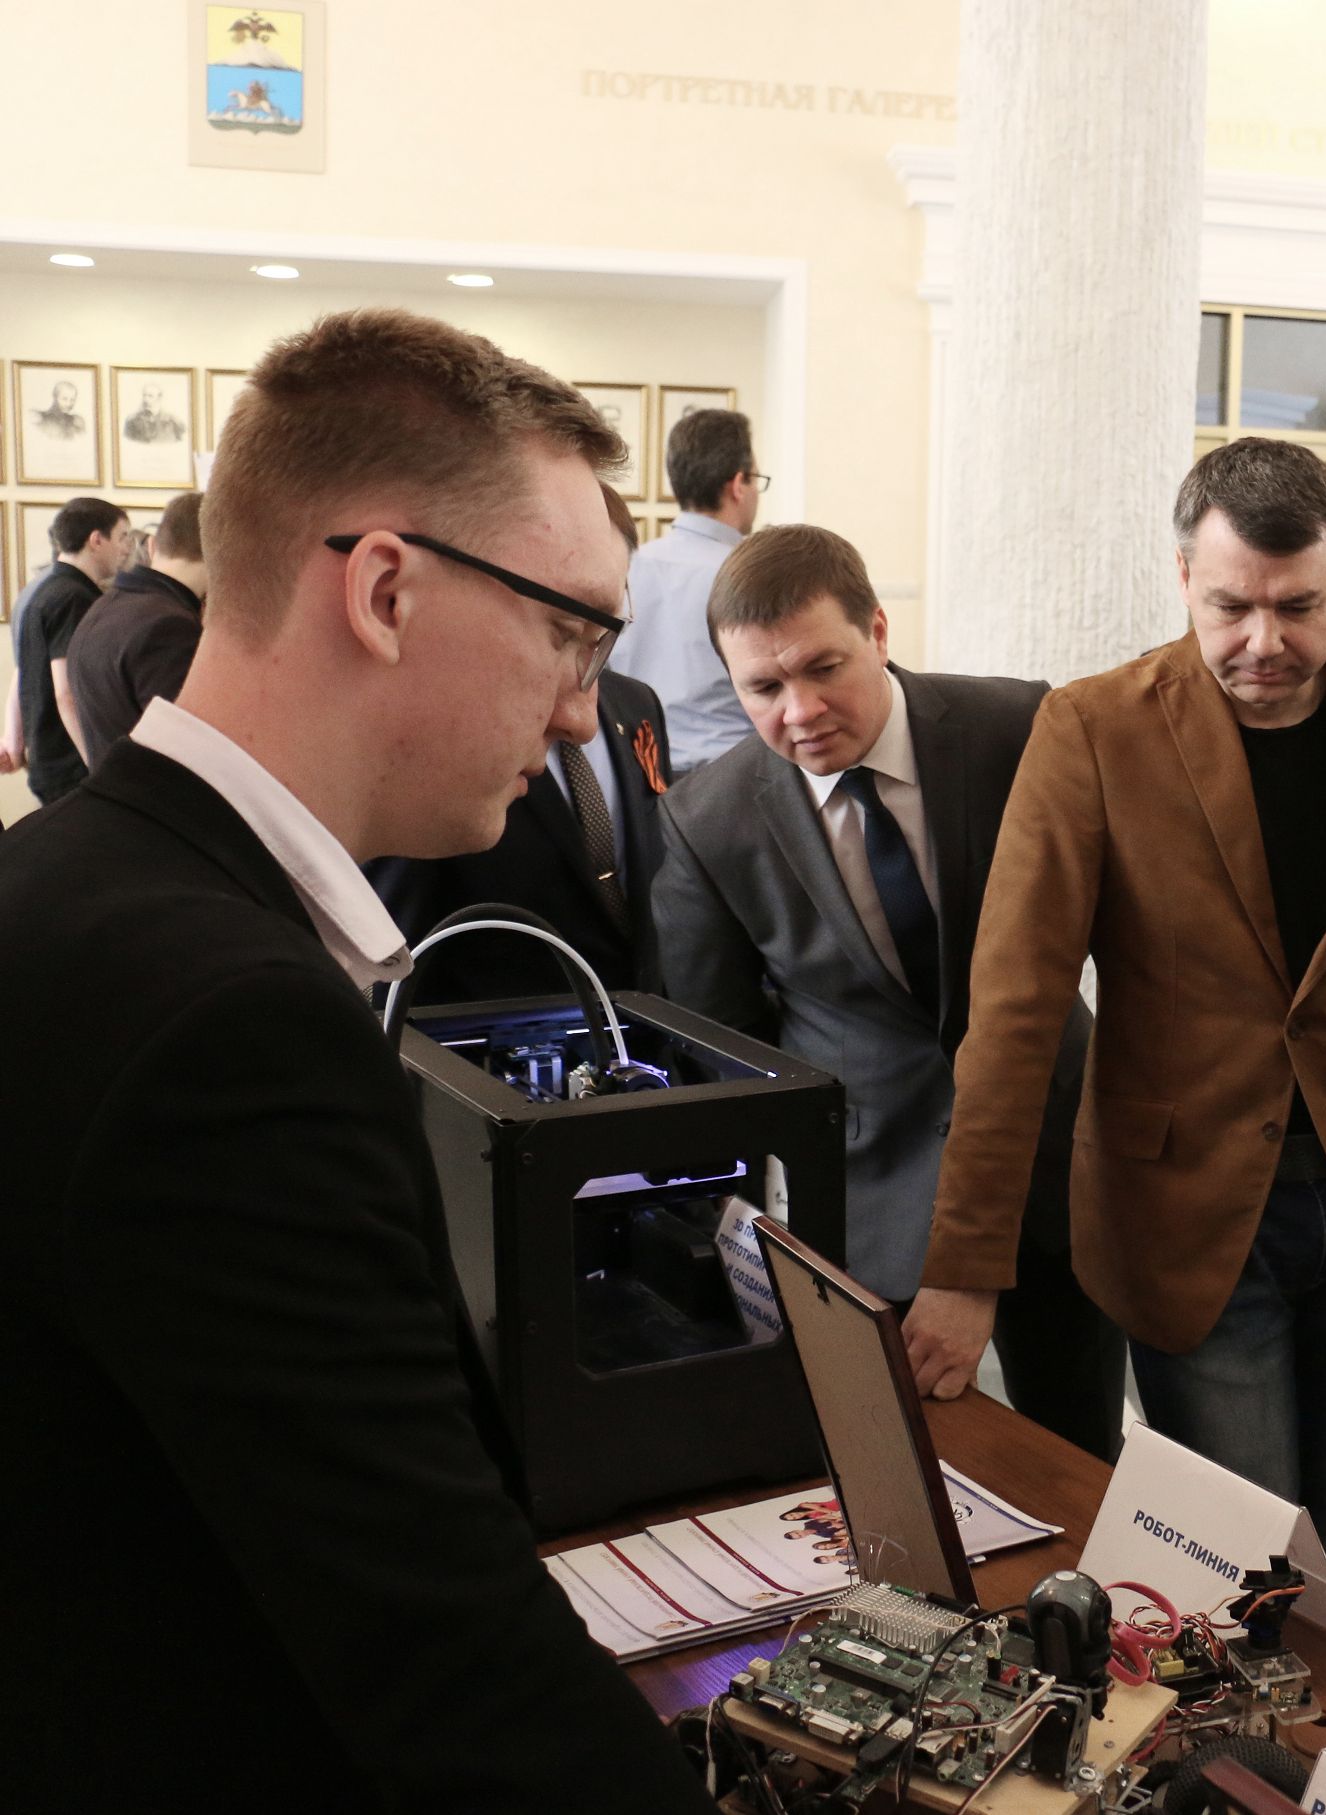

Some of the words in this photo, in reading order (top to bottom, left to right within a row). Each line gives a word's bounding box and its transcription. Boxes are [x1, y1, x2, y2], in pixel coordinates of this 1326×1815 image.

[580, 69, 815, 111] ПОРТРЕТНАЯ
[827, 86, 957, 121] ГАЛЕРЕ
[1133, 1509, 1240, 1582] РОБОТ-ЛИНИЯ
